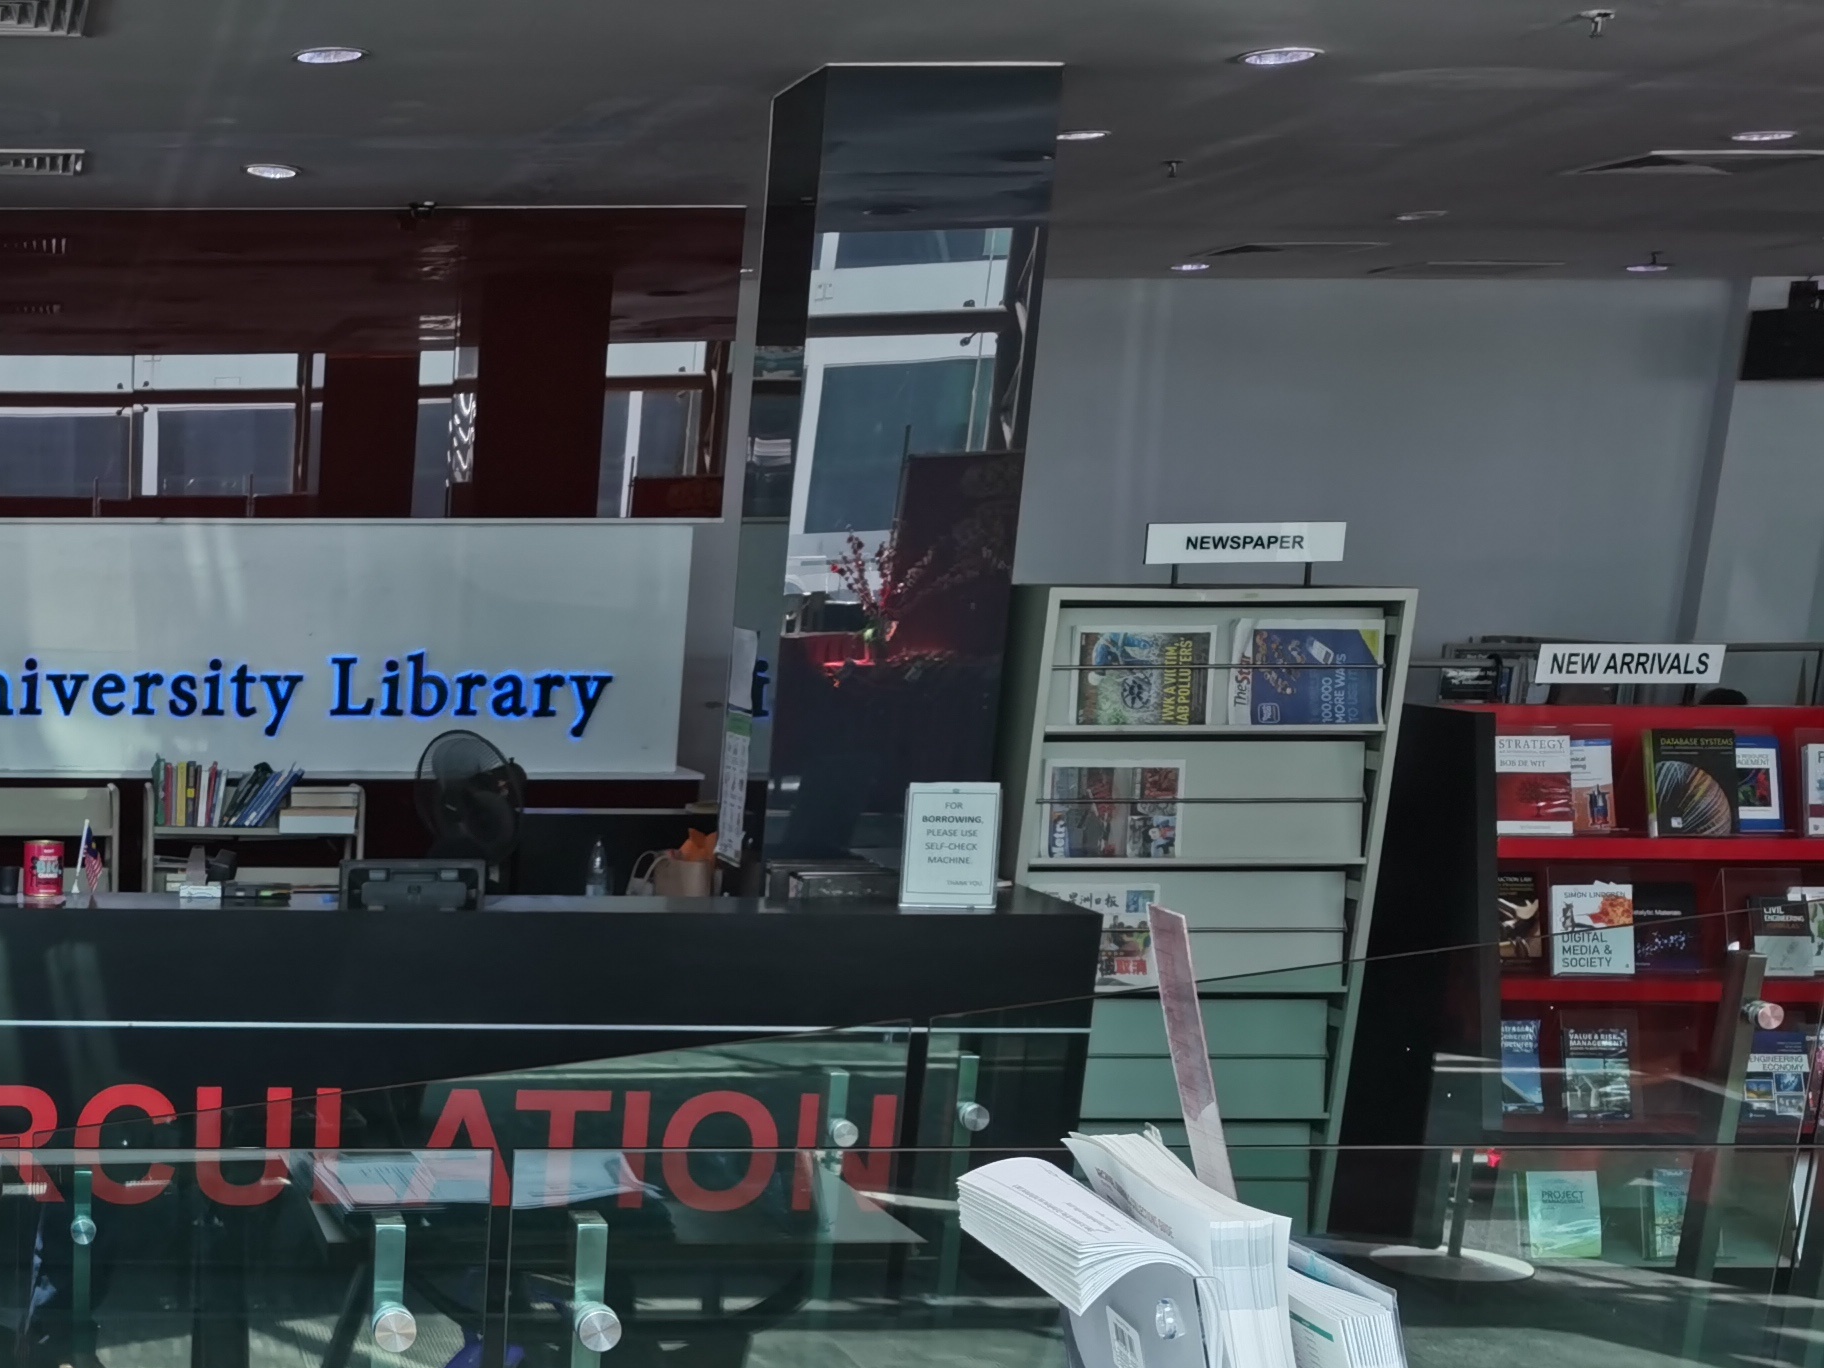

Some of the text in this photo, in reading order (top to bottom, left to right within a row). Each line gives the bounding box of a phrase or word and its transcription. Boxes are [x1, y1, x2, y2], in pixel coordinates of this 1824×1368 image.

[1186, 535, 1305, 550] NEWSPAPER
[1549, 652, 1711, 675] NEW ARRIVALS
[329, 648, 615, 740] Library
[1498, 738, 1565, 749] STRATEGY
[1660, 737, 1734, 746] DATABASE SYSTEMS
[944, 801, 964, 810] FOR
[922, 815, 984, 824] BORROWING,
[926, 828, 979, 837] PLEASE USE
[924, 842, 978, 851] SELF-CHECK
[1564, 891, 1588, 899] SIMON
[1561, 931, 1608, 943] DIGITAL
[1562, 944, 1613, 956] MEDIA &
[1561, 956, 1613, 968] SOCIETY
[1762, 1063, 1805, 1072] ECONOMY
[1541, 1190, 1584, 1200] PROJECT
